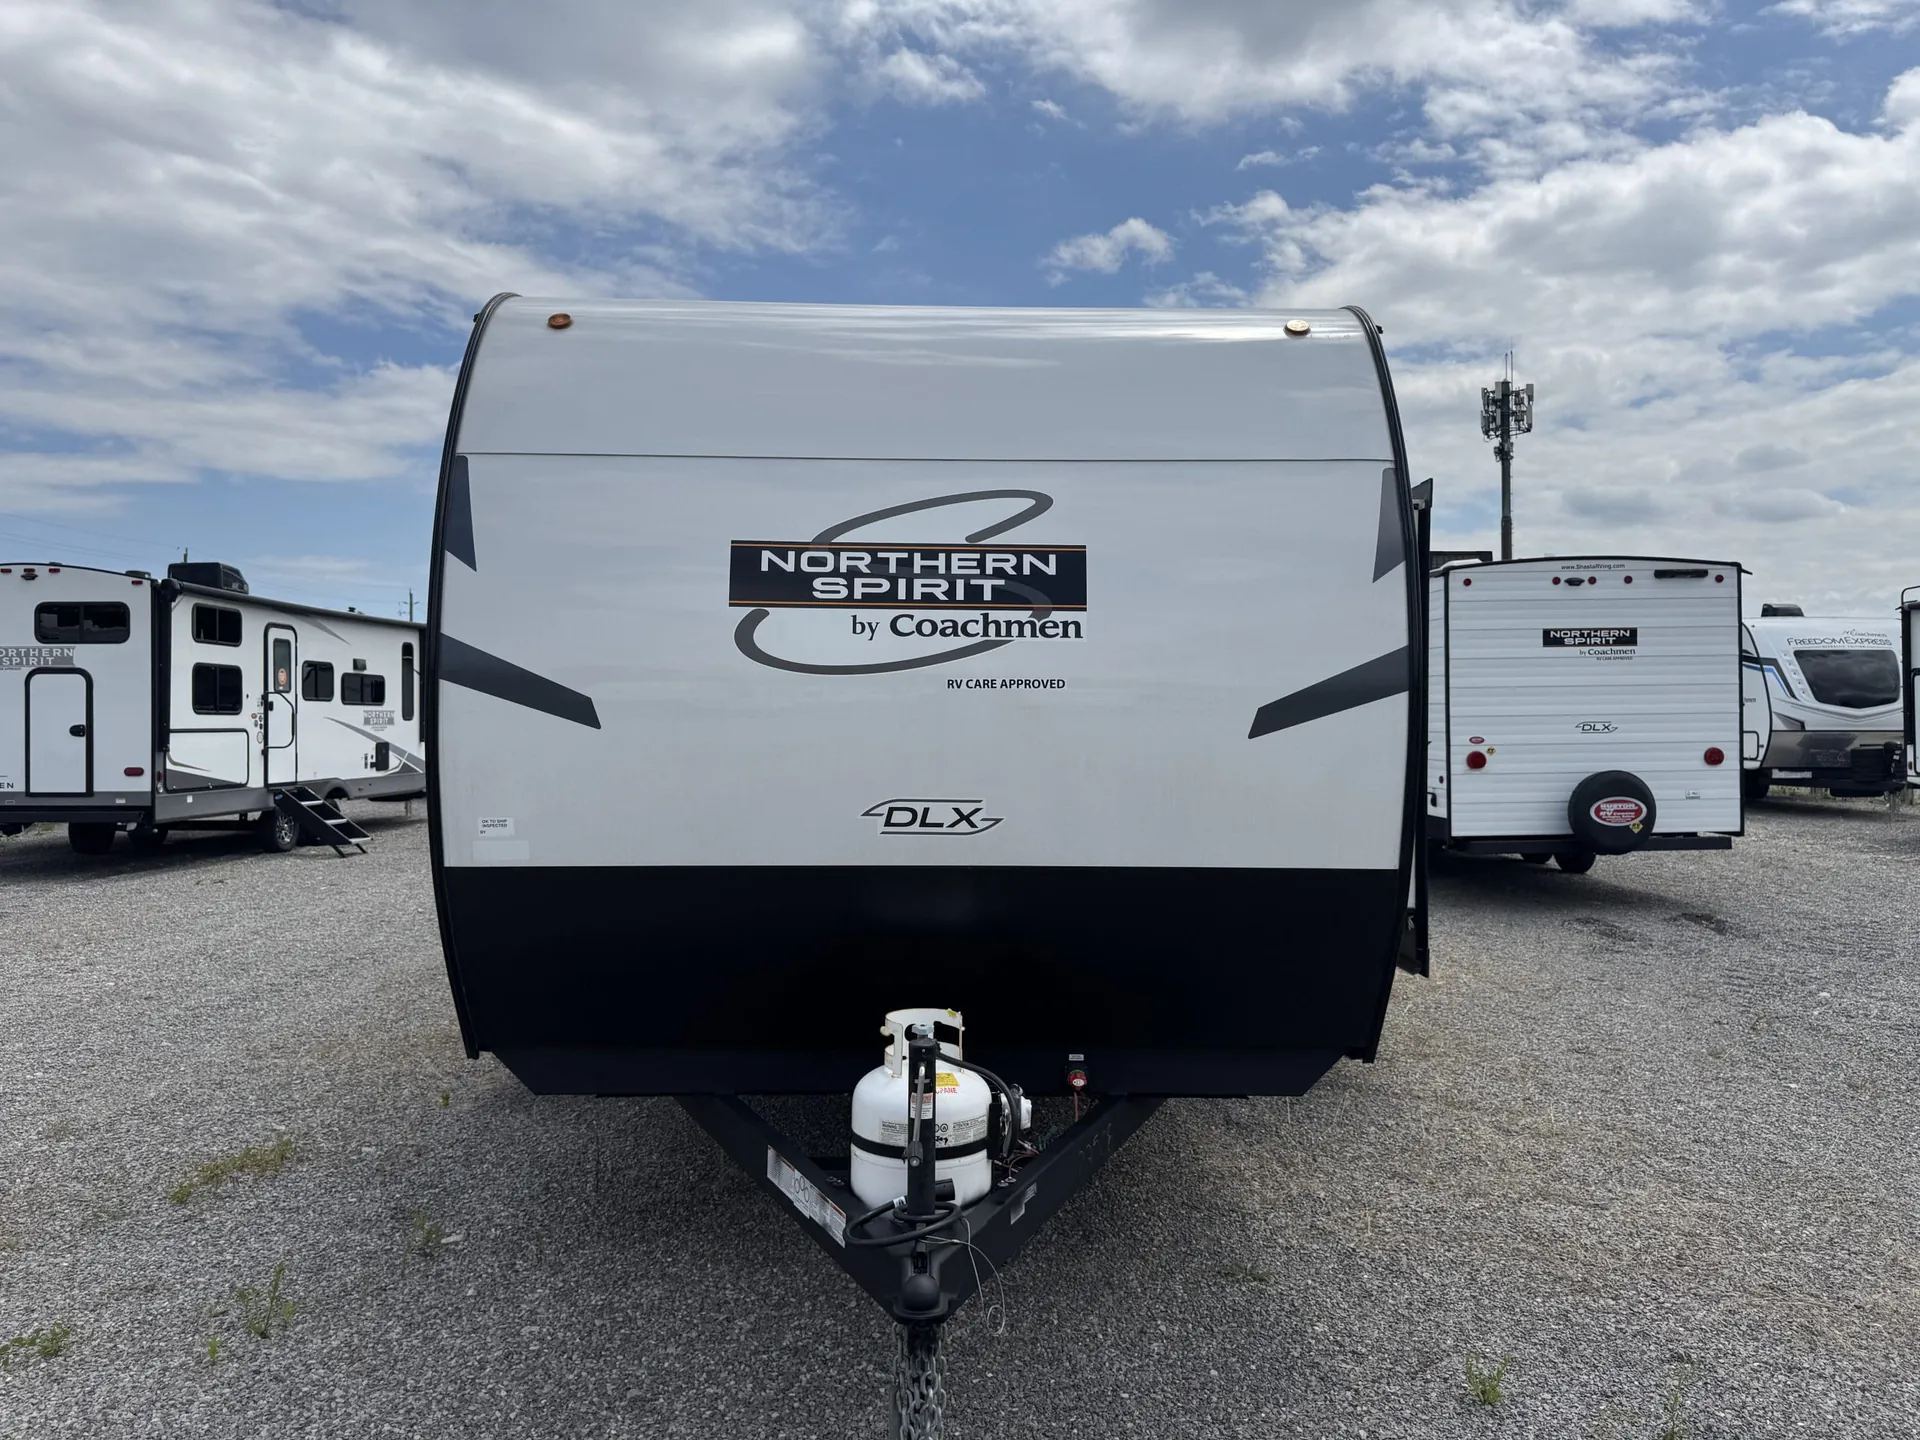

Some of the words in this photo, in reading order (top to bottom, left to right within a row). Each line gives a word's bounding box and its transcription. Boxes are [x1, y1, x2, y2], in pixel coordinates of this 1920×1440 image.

[761, 550, 1056, 576] NORTHERN
[812, 577, 1006, 601] SPIRIT
[851, 615, 880, 641] by
[890, 612, 1083, 639] Coachmen
[1550, 630, 1630, 638] NORTHERN
[1564, 637, 1616, 645] SPIRIT
[0, 648, 73, 657] ORTHERN
[1587, 648, 1636, 656] Coachmen
[2, 657, 54, 666] SPIRIT
[947, 679, 963, 689] RV
[966, 679, 997, 689] CARE
[1000, 679, 1066, 689] APPROVED
[883, 806, 984, 829] DLX
